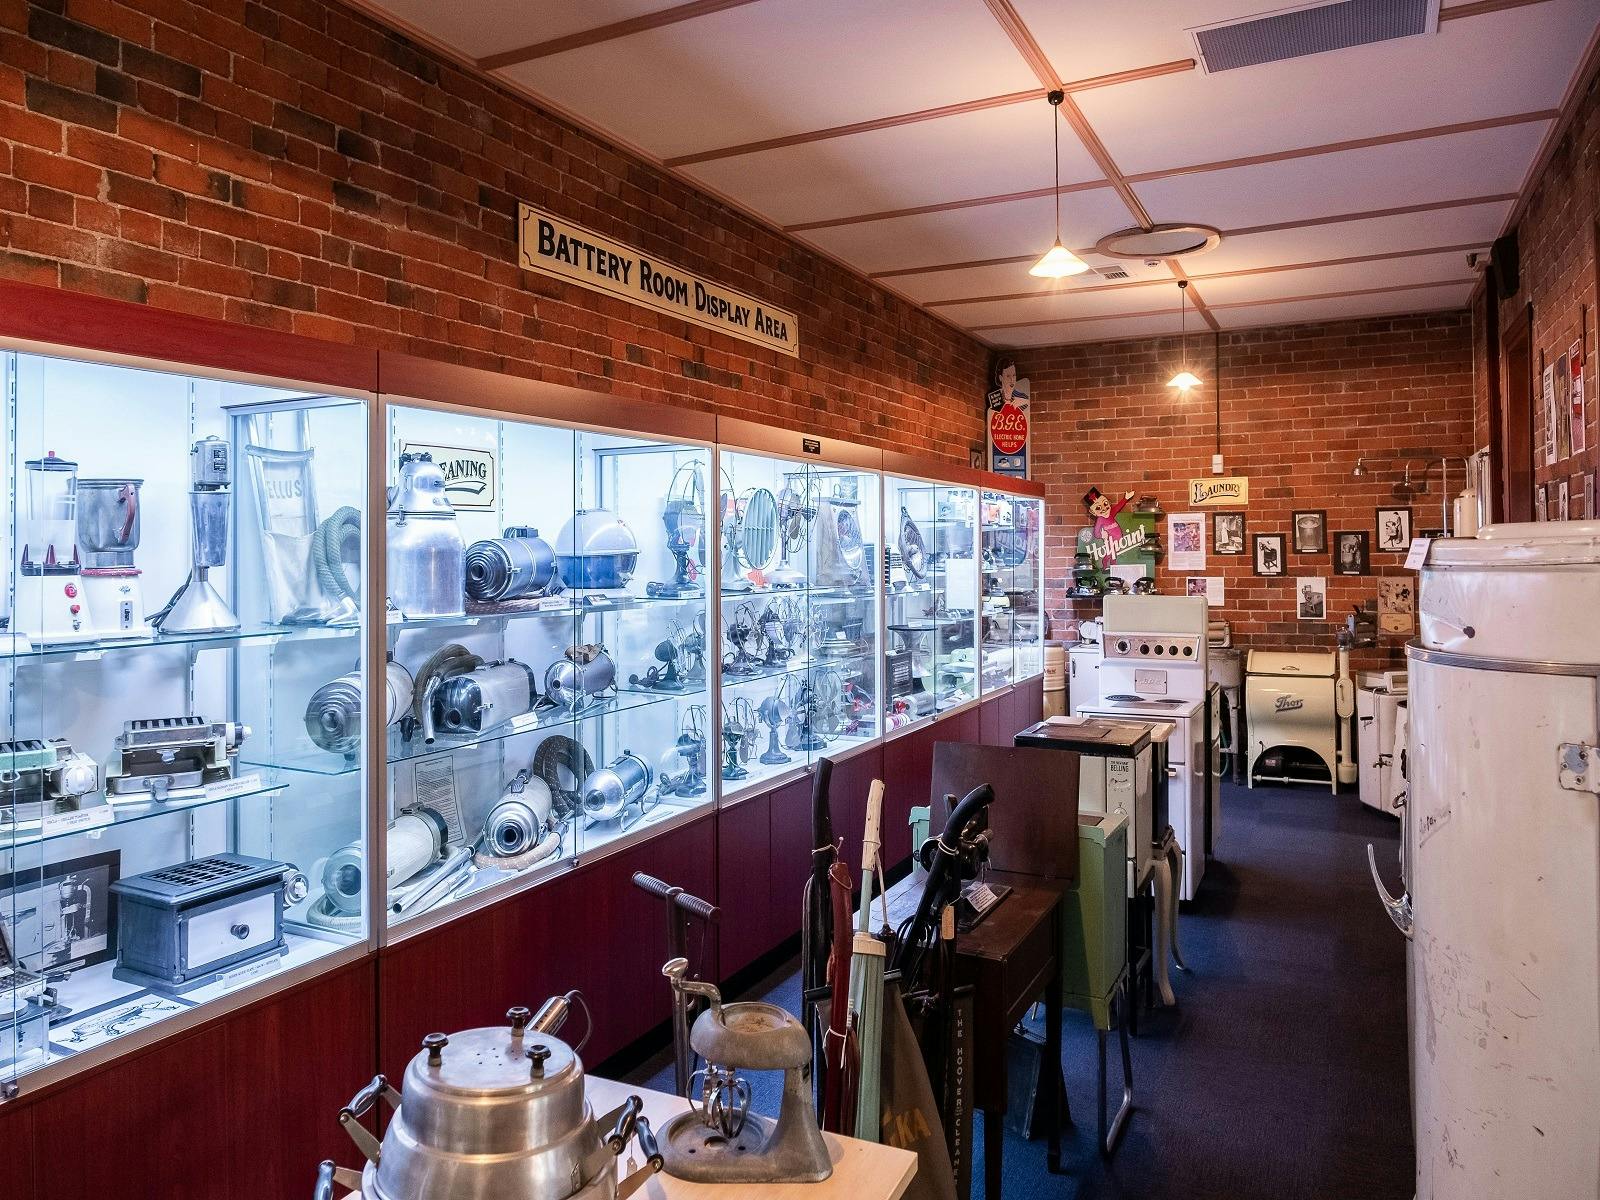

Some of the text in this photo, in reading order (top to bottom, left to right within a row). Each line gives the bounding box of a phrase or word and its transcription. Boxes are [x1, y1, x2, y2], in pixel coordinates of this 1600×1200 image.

[538, 219, 788, 341] BATTERY ROOM DISPLAY AREA
[991, 414, 1025, 431] B.G.E.
[438, 459, 487, 481] EANING
[266, 479, 303, 499] ELLUS
[1193, 482, 1240, 504] LAUNDRY
[1085, 524, 1147, 561] Hotpoint
[1274, 695, 1304, 711] Thor
